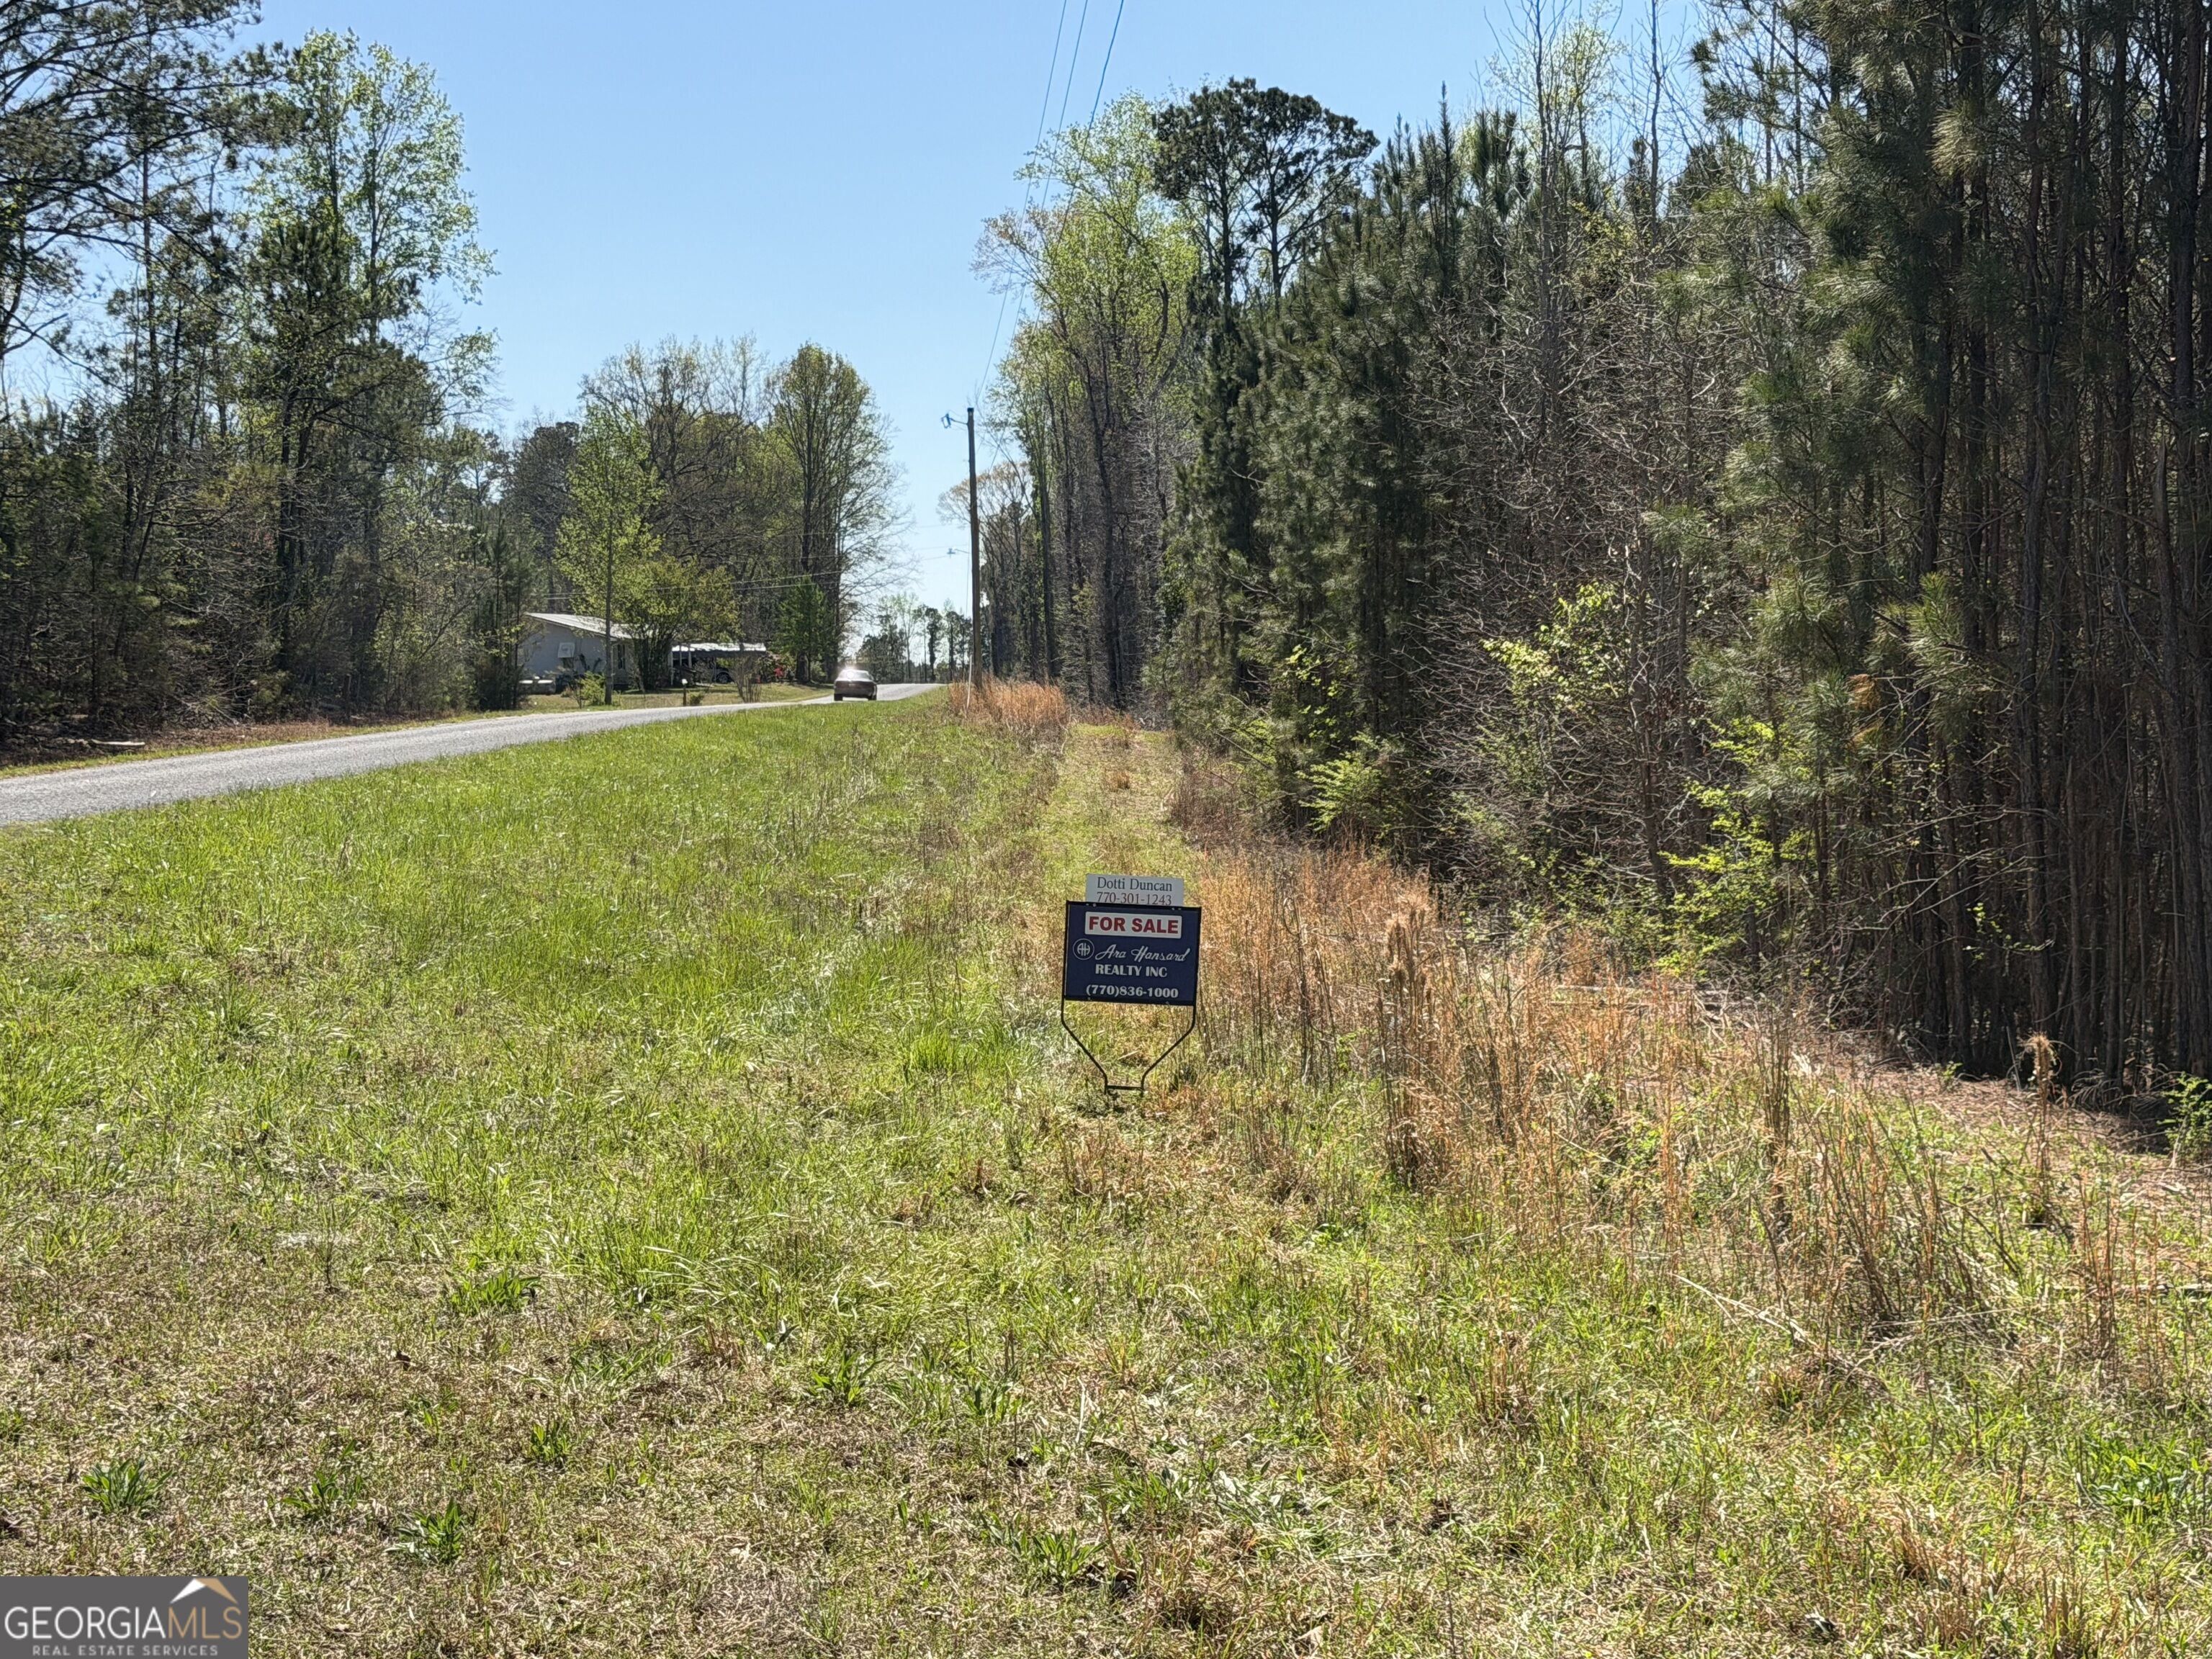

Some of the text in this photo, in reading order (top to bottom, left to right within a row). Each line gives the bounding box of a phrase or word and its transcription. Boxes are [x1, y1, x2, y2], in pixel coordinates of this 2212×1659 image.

[1097, 876, 1172, 891] Dotti Duncan
[1097, 891, 1172, 906] 770-301-1243
[1089, 916, 1179, 934] FOR SALE
[1094, 944, 1190, 963] Ara Hansard
[1095, 963, 1167, 978] REALTY INC
[1086, 984, 1179, 998] (770)836-1000
